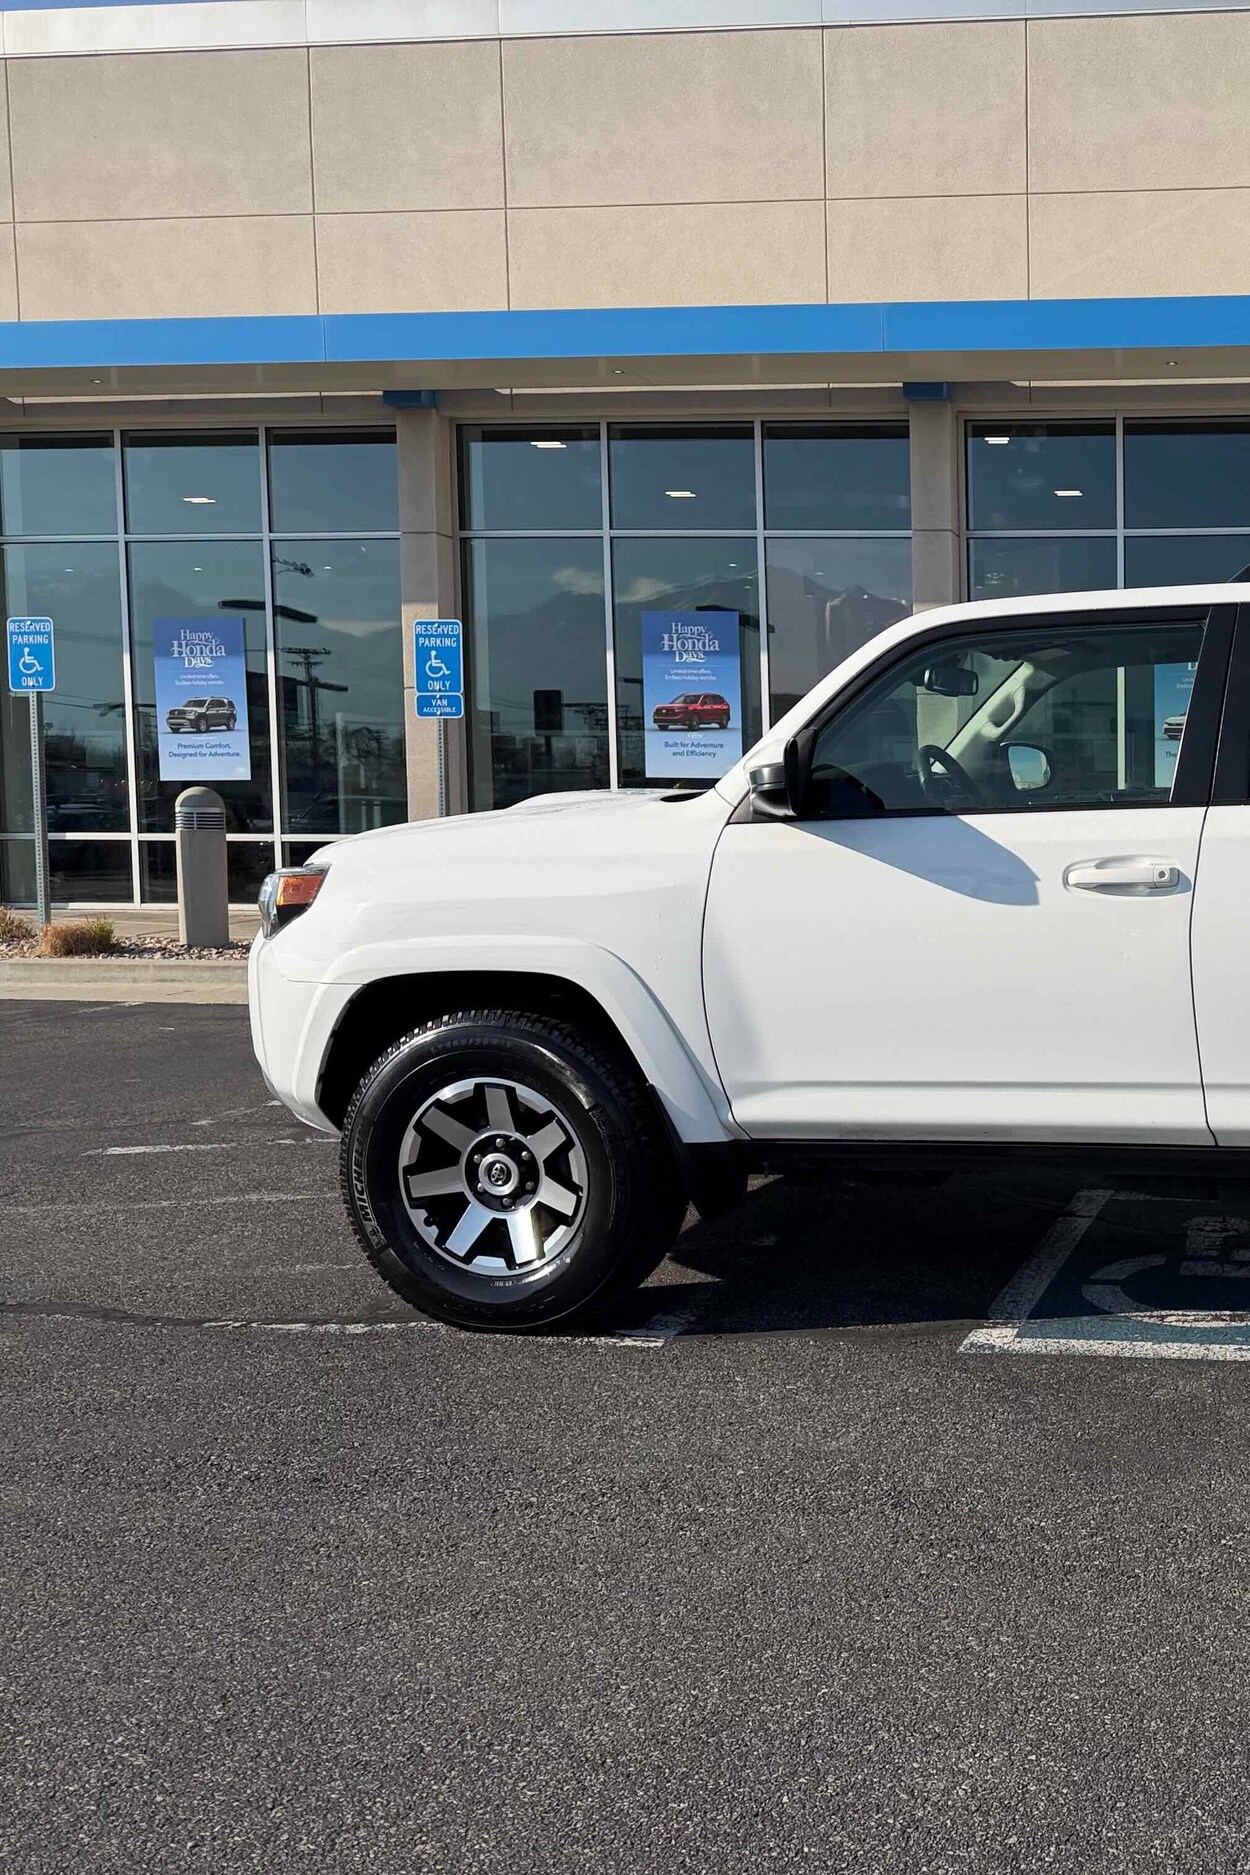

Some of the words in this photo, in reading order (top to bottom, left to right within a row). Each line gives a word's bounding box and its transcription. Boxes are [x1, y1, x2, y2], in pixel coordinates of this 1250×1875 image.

[9, 622, 51, 632] RESERVED
[416, 624, 459, 635] RESERVED
[671, 622, 707, 637] Happy
[12, 635, 49, 644] PARKING
[180, 629, 214, 643] Happy
[418, 637, 457, 647] PARKING
[660, 633, 720, 652] Honda
[170, 640, 226, 657] Honda
[675, 650, 706, 663] Days
[185, 656, 214, 668] Days
[22, 677, 43, 686] ONLY
[427, 680, 451, 690] ONLY
[169, 751, 198, 759] Designed
[686, 750, 716, 758] Efficiency
